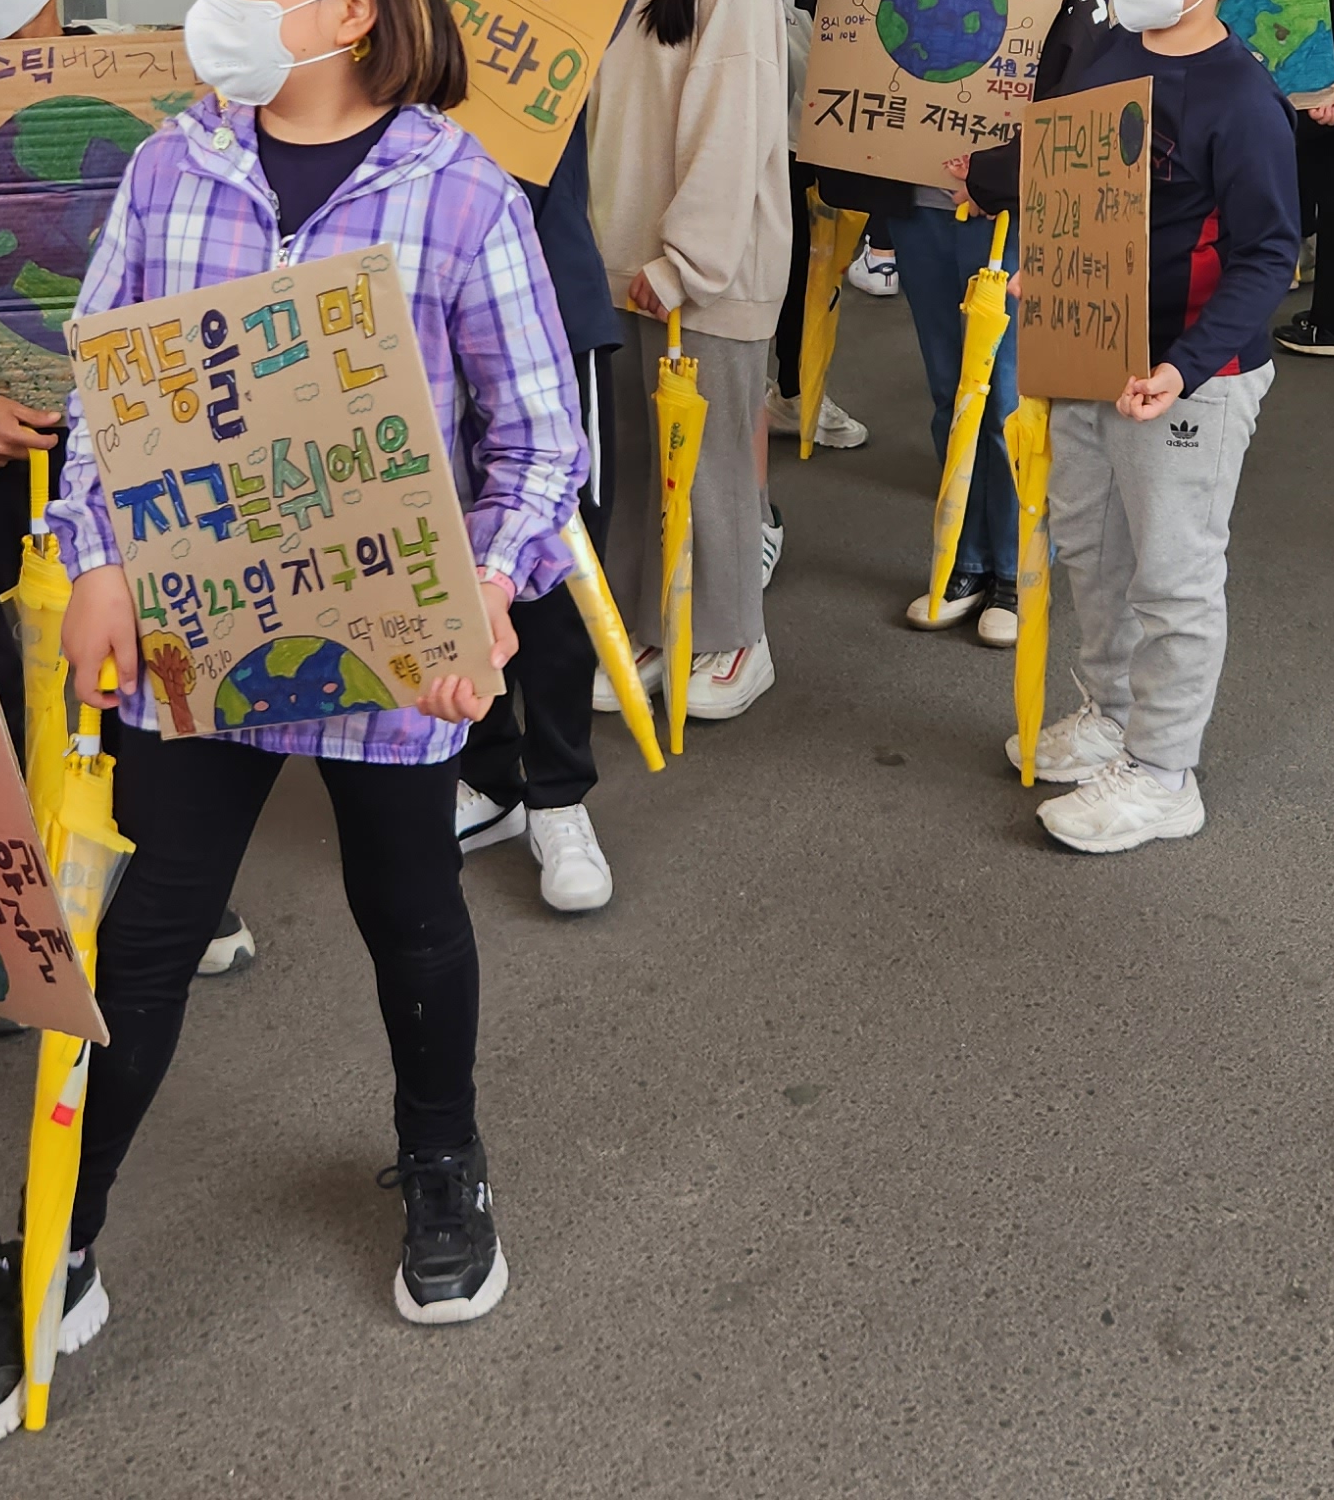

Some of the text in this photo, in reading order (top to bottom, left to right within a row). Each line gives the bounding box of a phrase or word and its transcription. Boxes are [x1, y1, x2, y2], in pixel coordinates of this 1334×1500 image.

[821, 16, 840, 31] 8시
[839, 30, 858, 43] 10분
[986, 79, 1034, 102] 지구의
[813, 88, 909, 134] 지구를
[1025, 178, 1081, 240] 4월 22일
[79, 308, 248, 443] 전등을
[1166, 438, 1200, 449] adidas
[111, 459, 285, 545] 지구는
[347, 615, 375, 651] 딱
[390, 653, 422, 685] 전등
